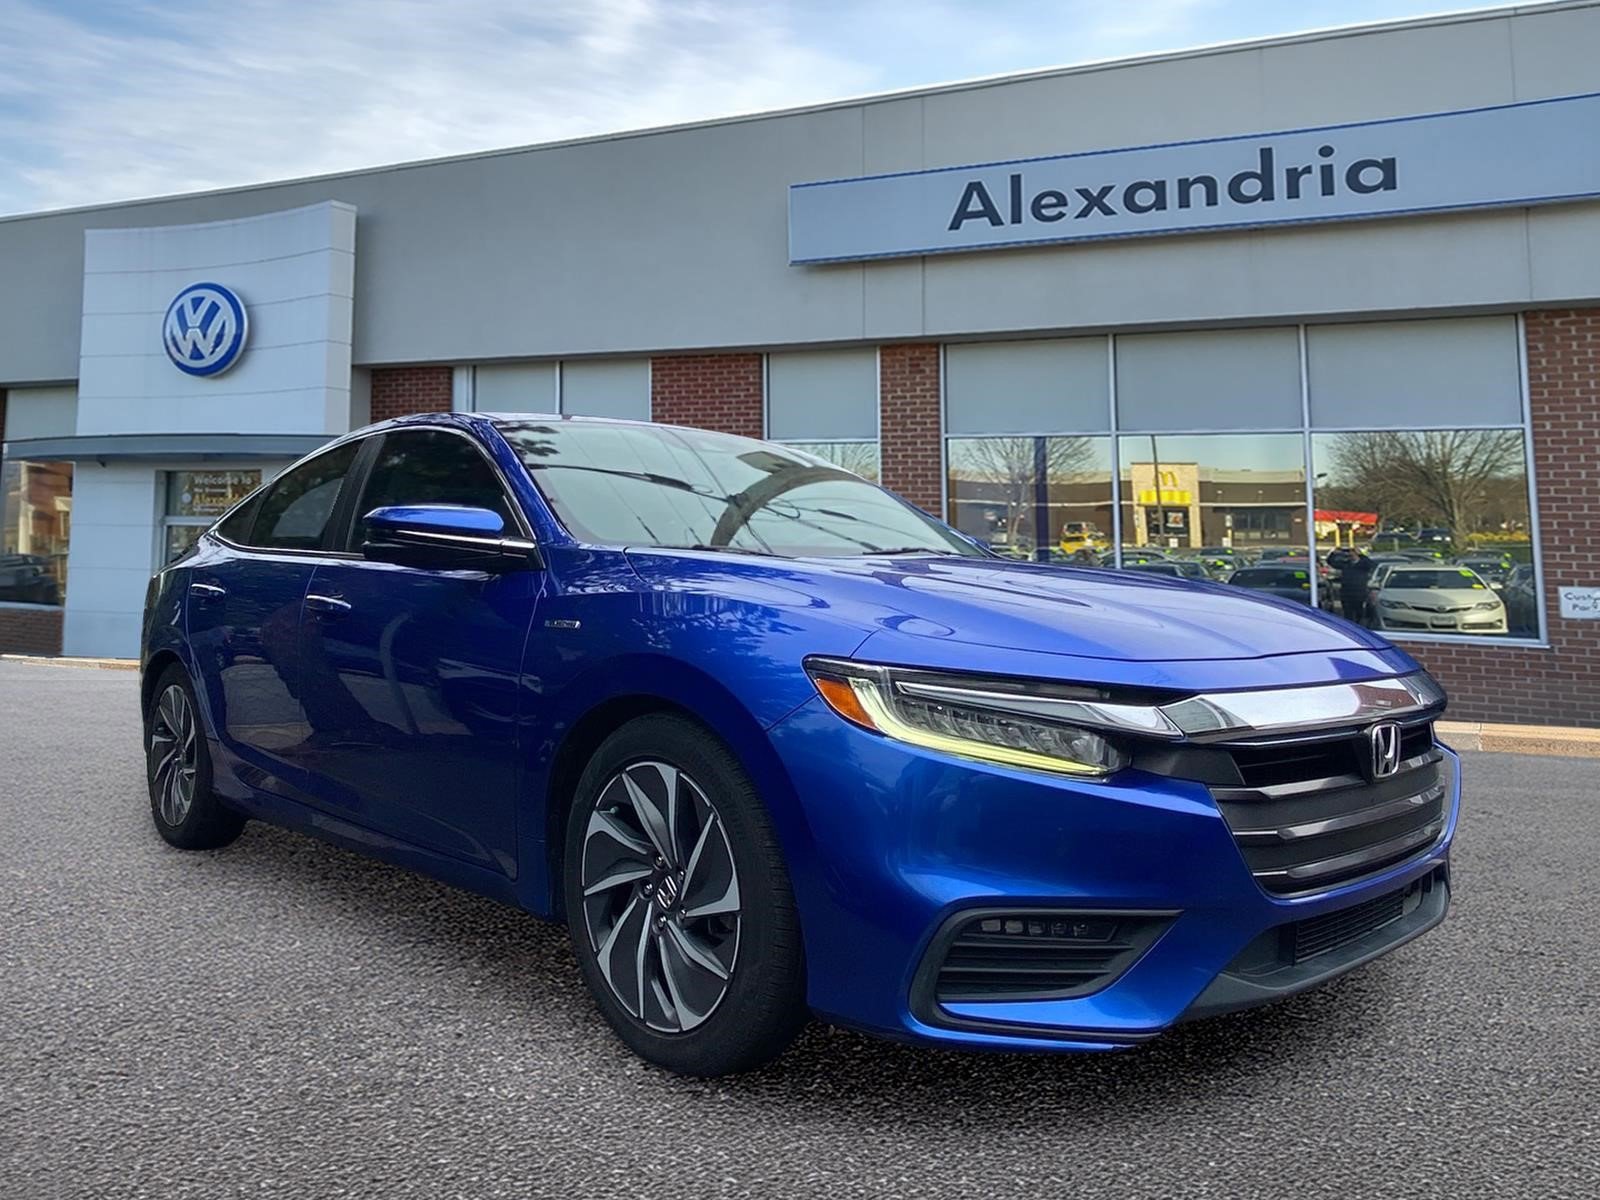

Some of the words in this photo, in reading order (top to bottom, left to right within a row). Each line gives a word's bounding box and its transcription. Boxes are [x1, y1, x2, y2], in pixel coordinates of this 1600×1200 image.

[948, 146, 1398, 231] Alexandria
[165, 288, 238, 368] VW
[194, 473, 239, 484] Welcome
